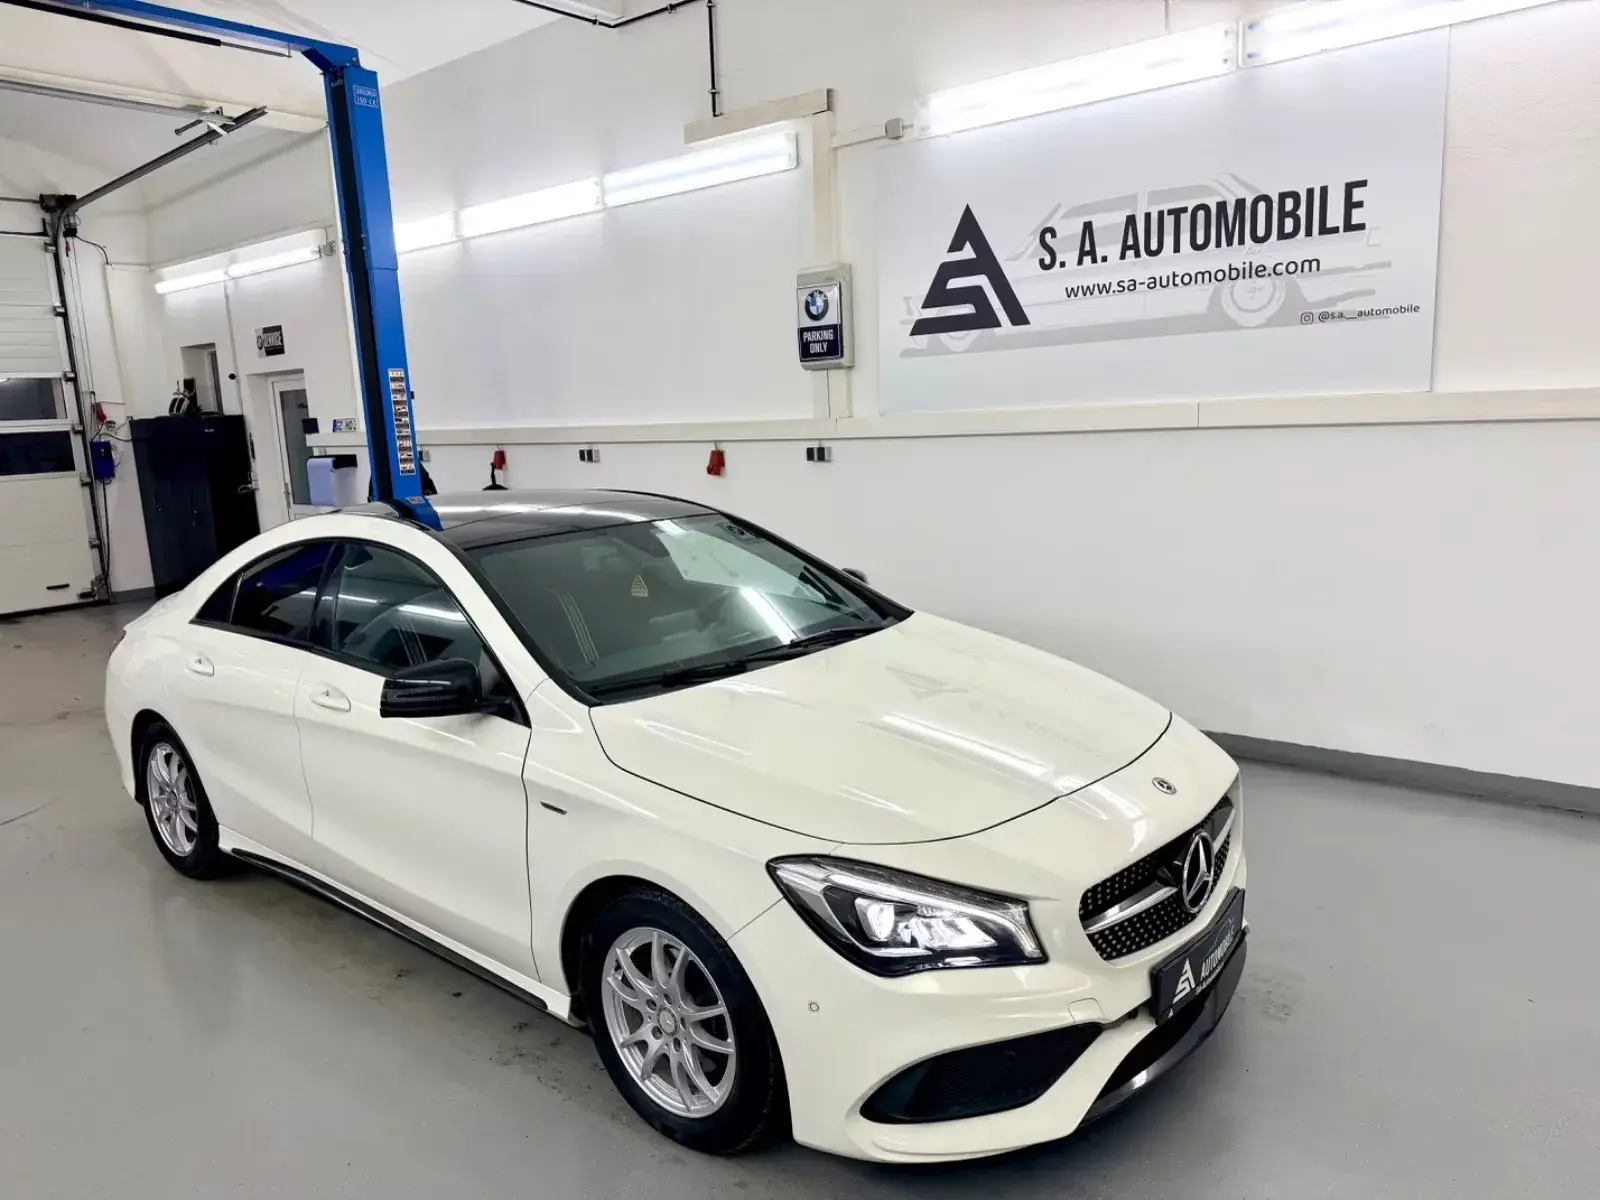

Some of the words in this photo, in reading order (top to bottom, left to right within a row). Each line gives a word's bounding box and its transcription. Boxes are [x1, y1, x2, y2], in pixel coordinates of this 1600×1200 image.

[1037, 226, 1067, 271] S.
[1077, 220, 1108, 266] A.
[1120, 179, 1368, 261] AUTOMOBILE
[1064, 257, 1322, 299] www.sa-automobile.com
[803, 329, 834, 343] PARKING
[809, 341, 828, 354] ONLY
